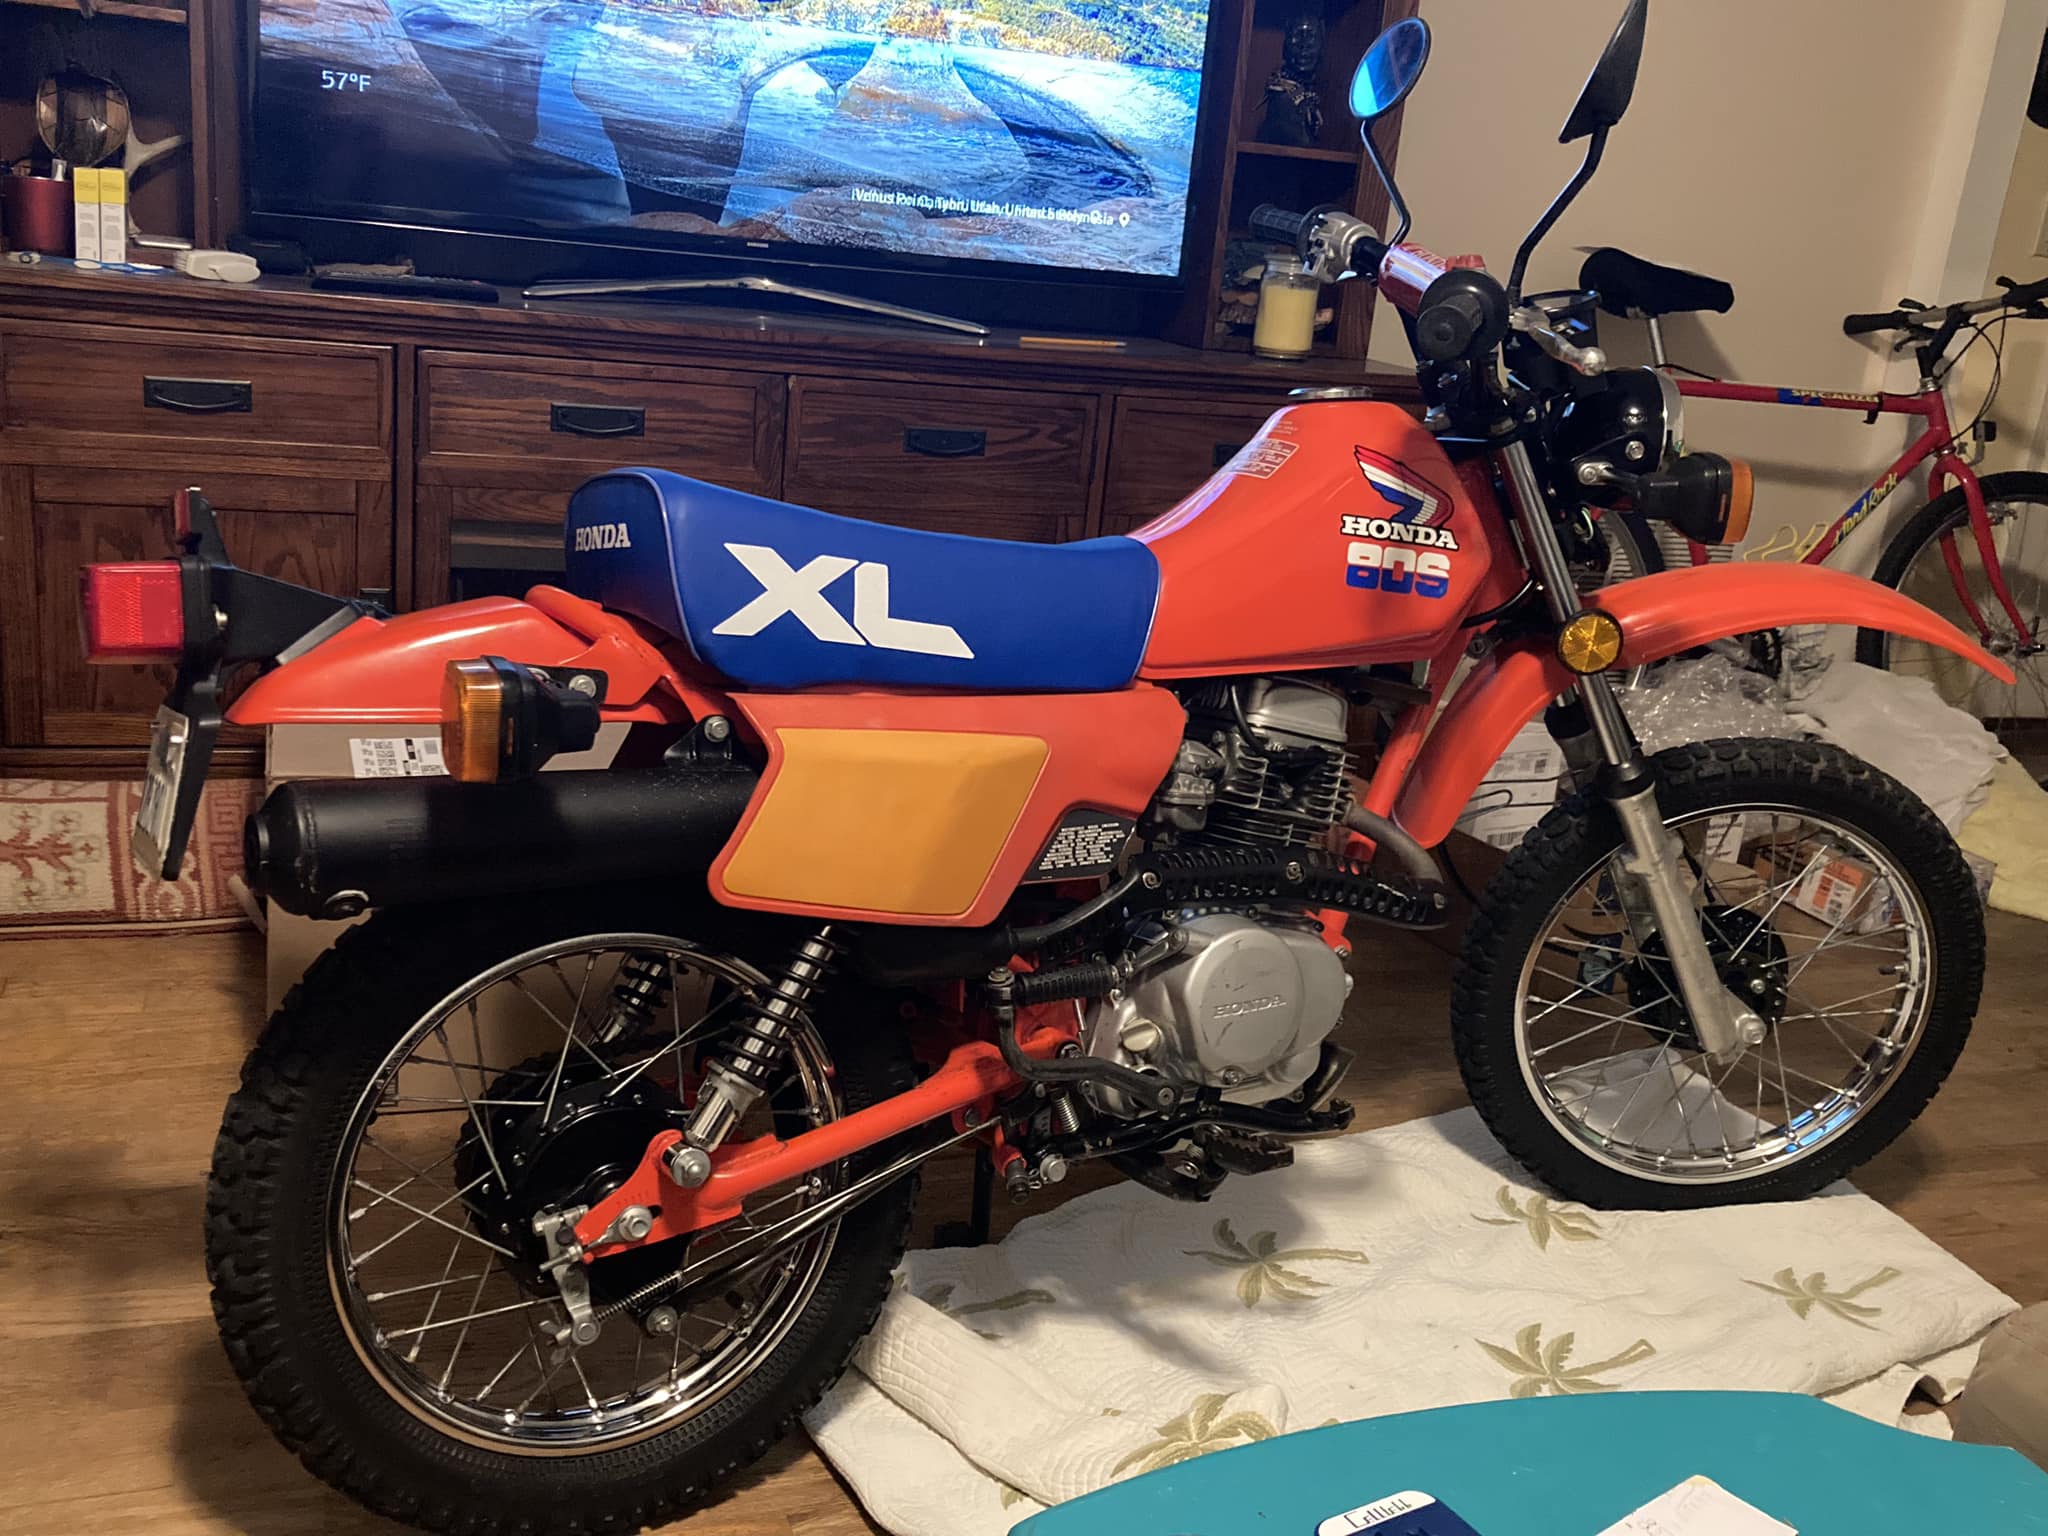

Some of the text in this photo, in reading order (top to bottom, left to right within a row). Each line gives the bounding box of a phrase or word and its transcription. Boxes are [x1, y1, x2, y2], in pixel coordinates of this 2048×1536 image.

[575, 523, 631, 551] HONDA
[1341, 515, 1459, 550] HONDA
[1346, 541, 1451, 599] 80S
[711, 542, 975, 660] XL
[1213, 994, 1287, 1019] HONDA
